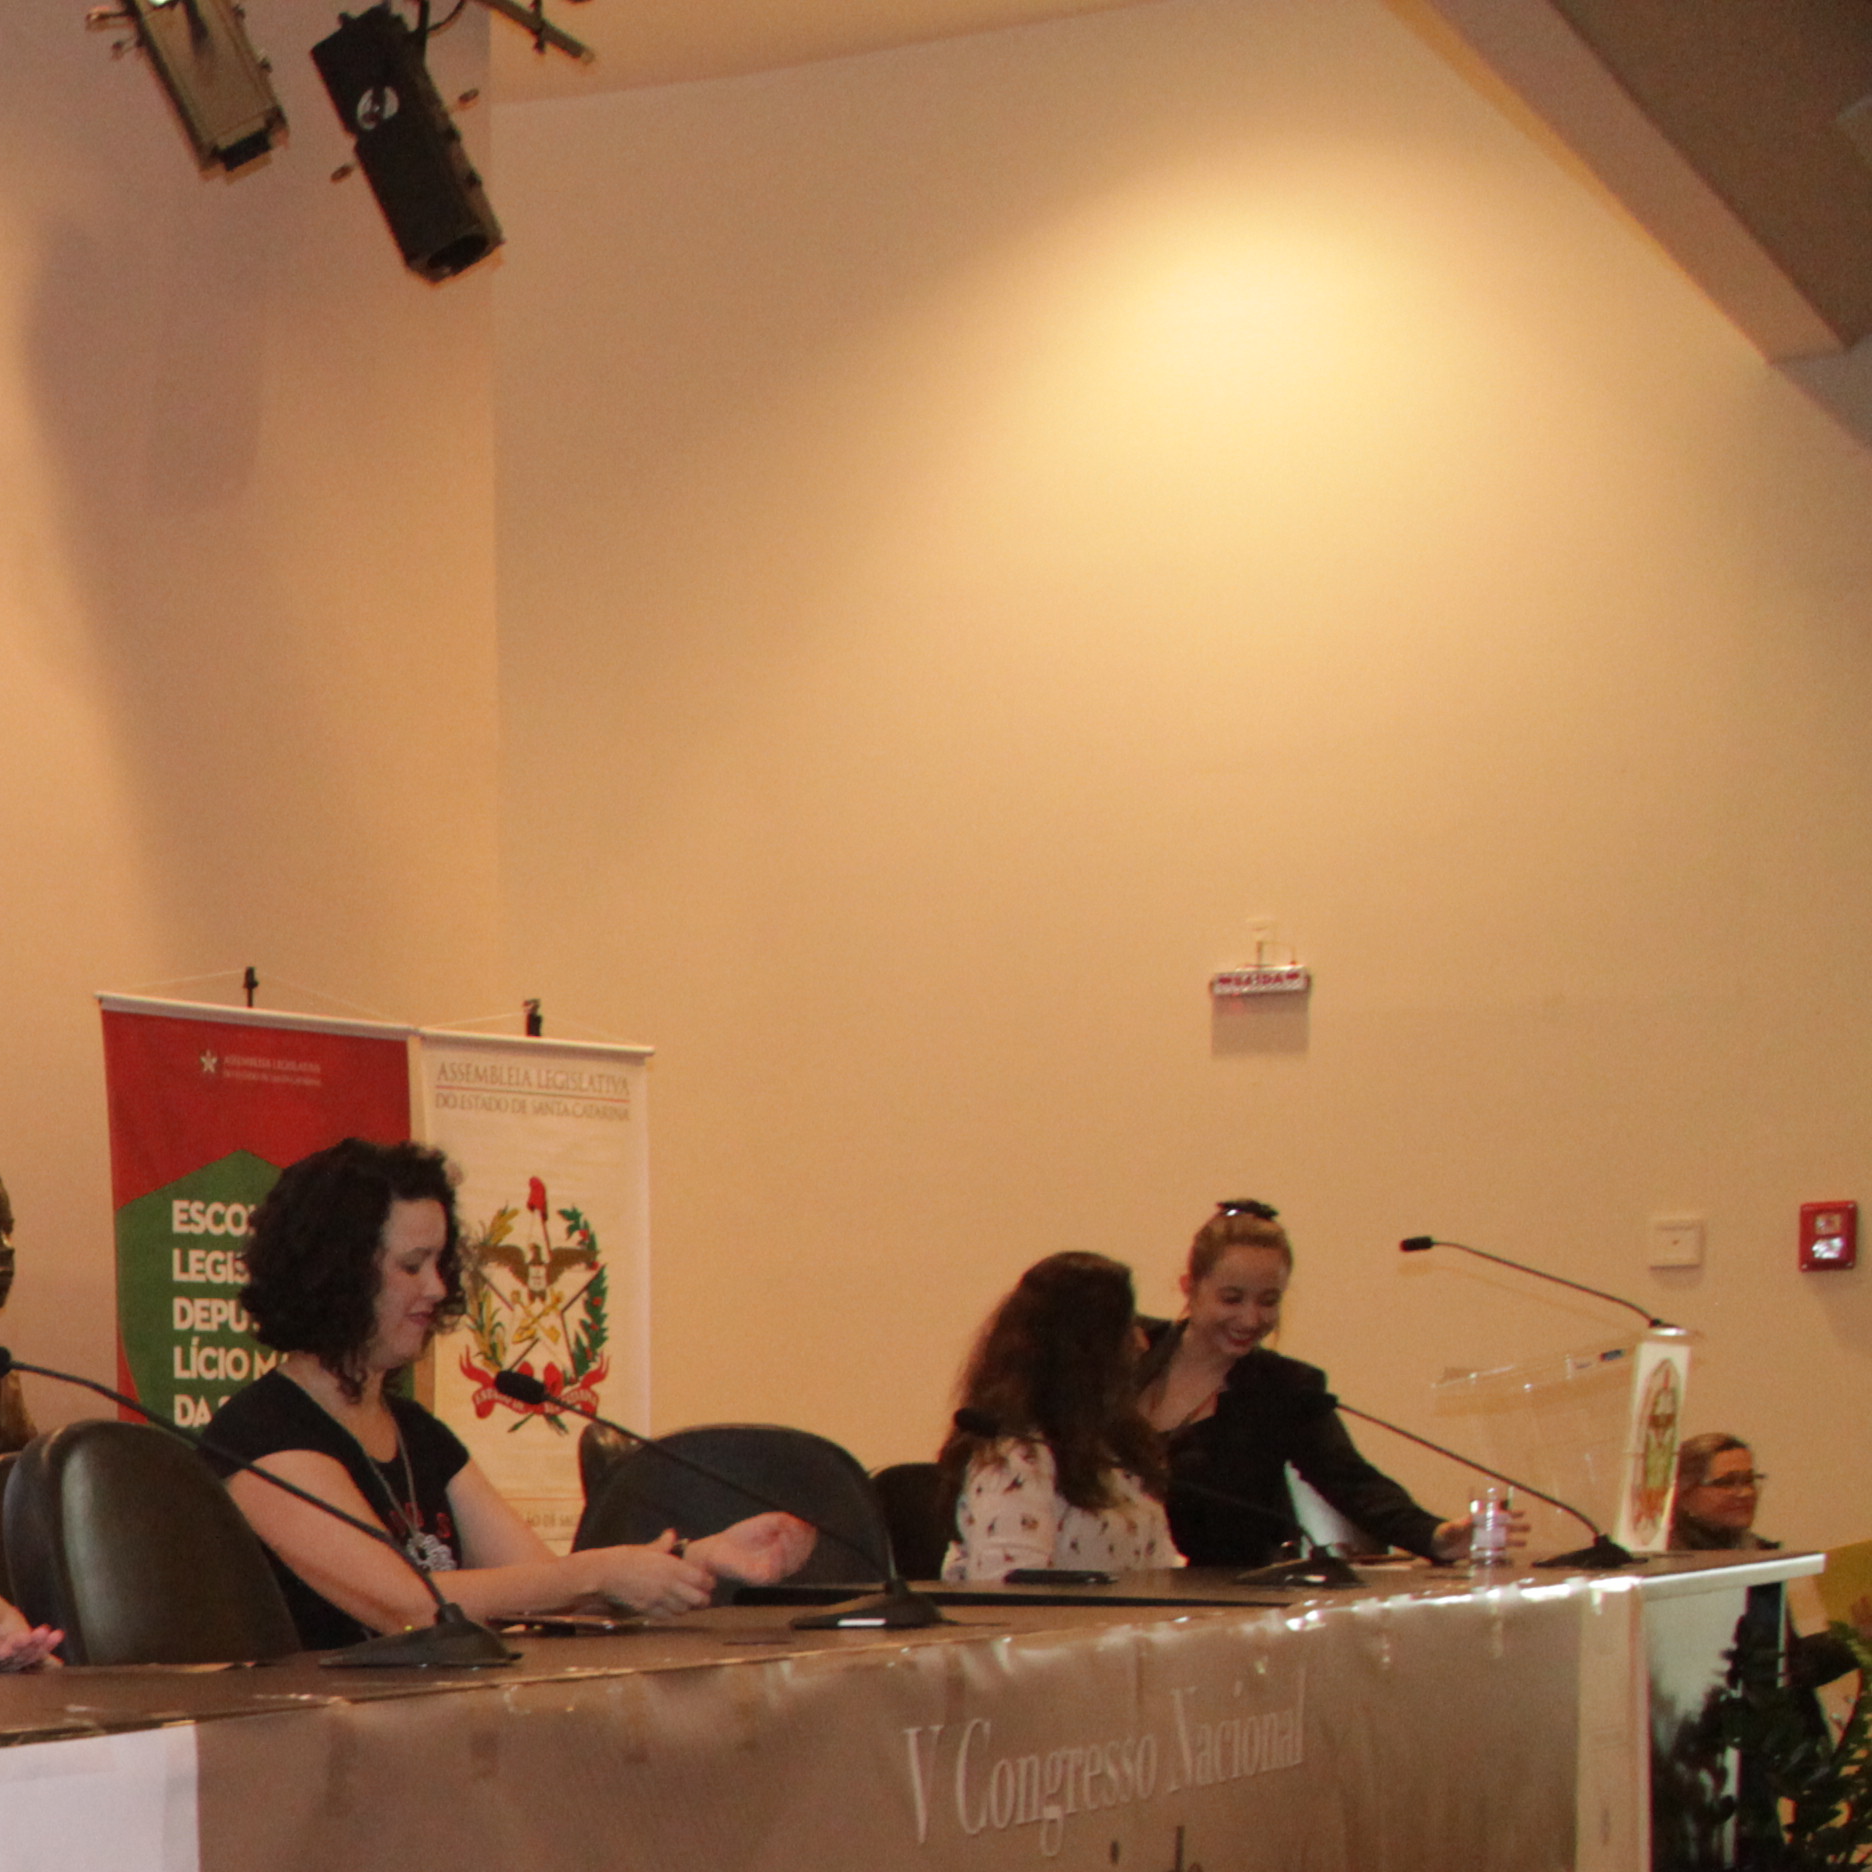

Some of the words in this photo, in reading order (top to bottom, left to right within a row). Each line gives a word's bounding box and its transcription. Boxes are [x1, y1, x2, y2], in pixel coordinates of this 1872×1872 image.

[437, 1062, 532, 1087] ASSEMBLEIA
[537, 1070, 630, 1096] LEGISLATIVA
[435, 1093, 457, 1109] DO
[459, 1094, 509, 1112] ESTADO
[511, 1098, 526, 1114] DE
[532, 1099, 570, 1117] SANTA
[571, 1102, 630, 1122] CATARINA
[173, 1200, 256, 1237] ESCO
[173, 1250, 249, 1284] LEGIS
[173, 1299, 252, 1332] DEPU
[174, 1337, 249, 1380] LÍCIO
[174, 1395, 212, 1428] DA
[903, 1723, 944, 1845] V
[955, 1718, 1158, 1857] Congresso
[1168, 1668, 1306, 1794] Nacional
